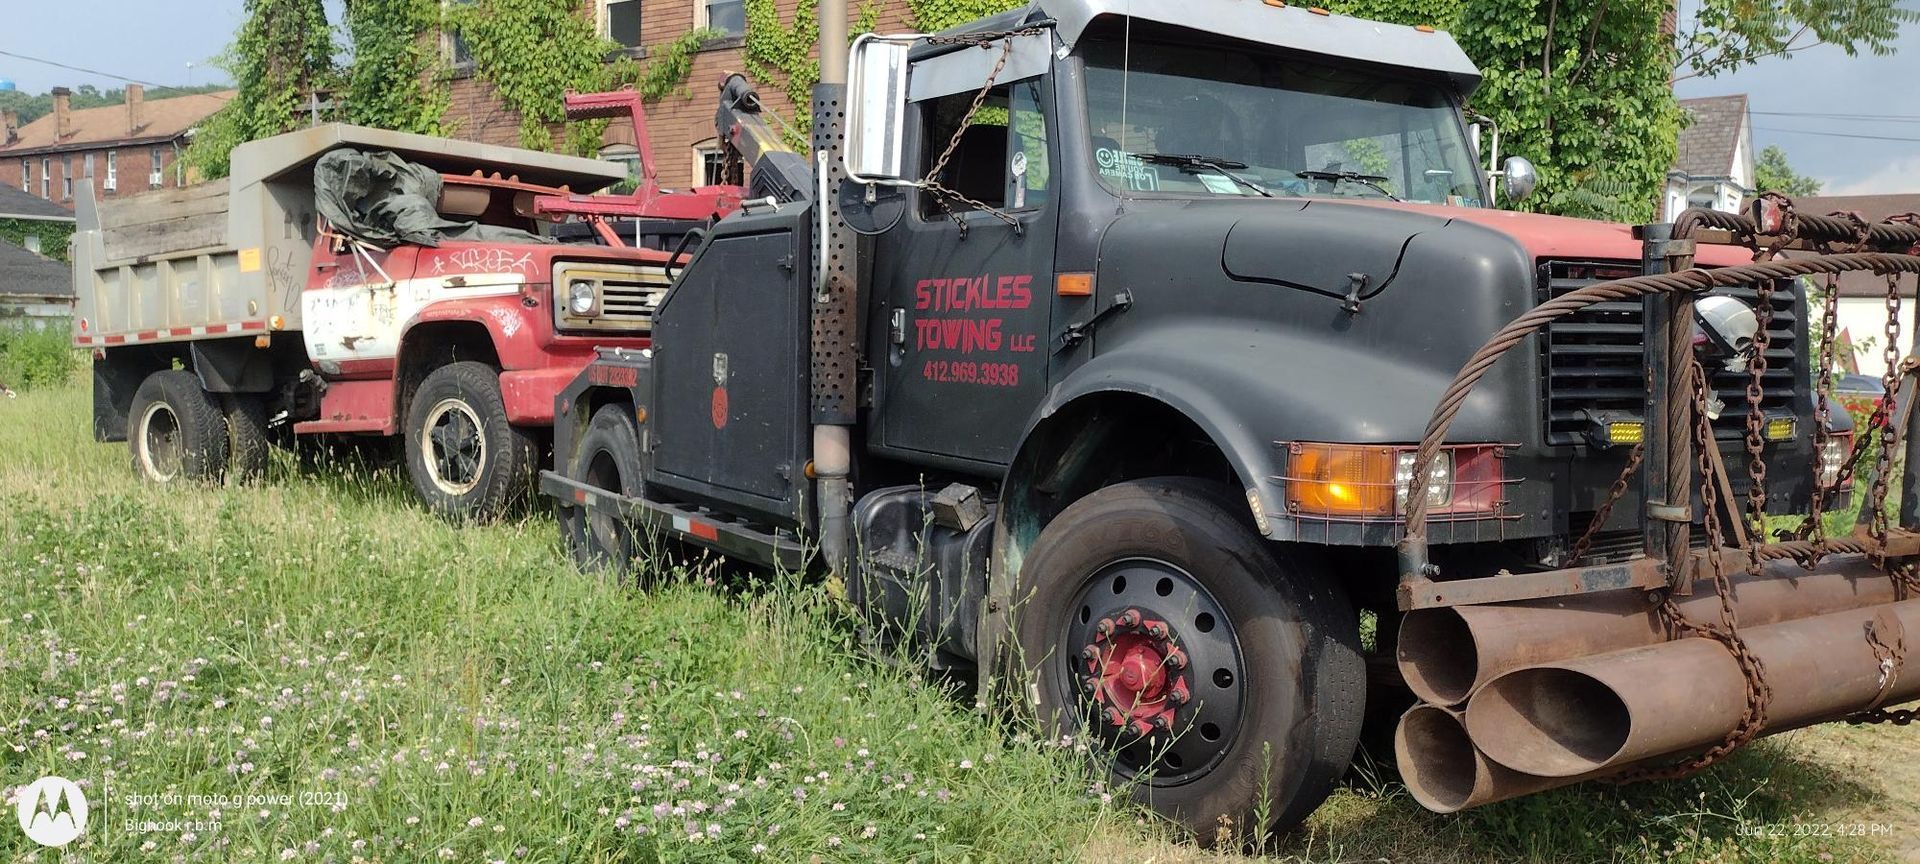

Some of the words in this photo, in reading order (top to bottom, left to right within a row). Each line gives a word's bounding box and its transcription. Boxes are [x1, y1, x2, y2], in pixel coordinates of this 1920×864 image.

[916, 273, 1033, 313] STICKLES
[915, 318, 1003, 354] TOWING
[1010, 334, 1036, 352] LLC
[923, 361, 1019, 386] 412.969.3938
